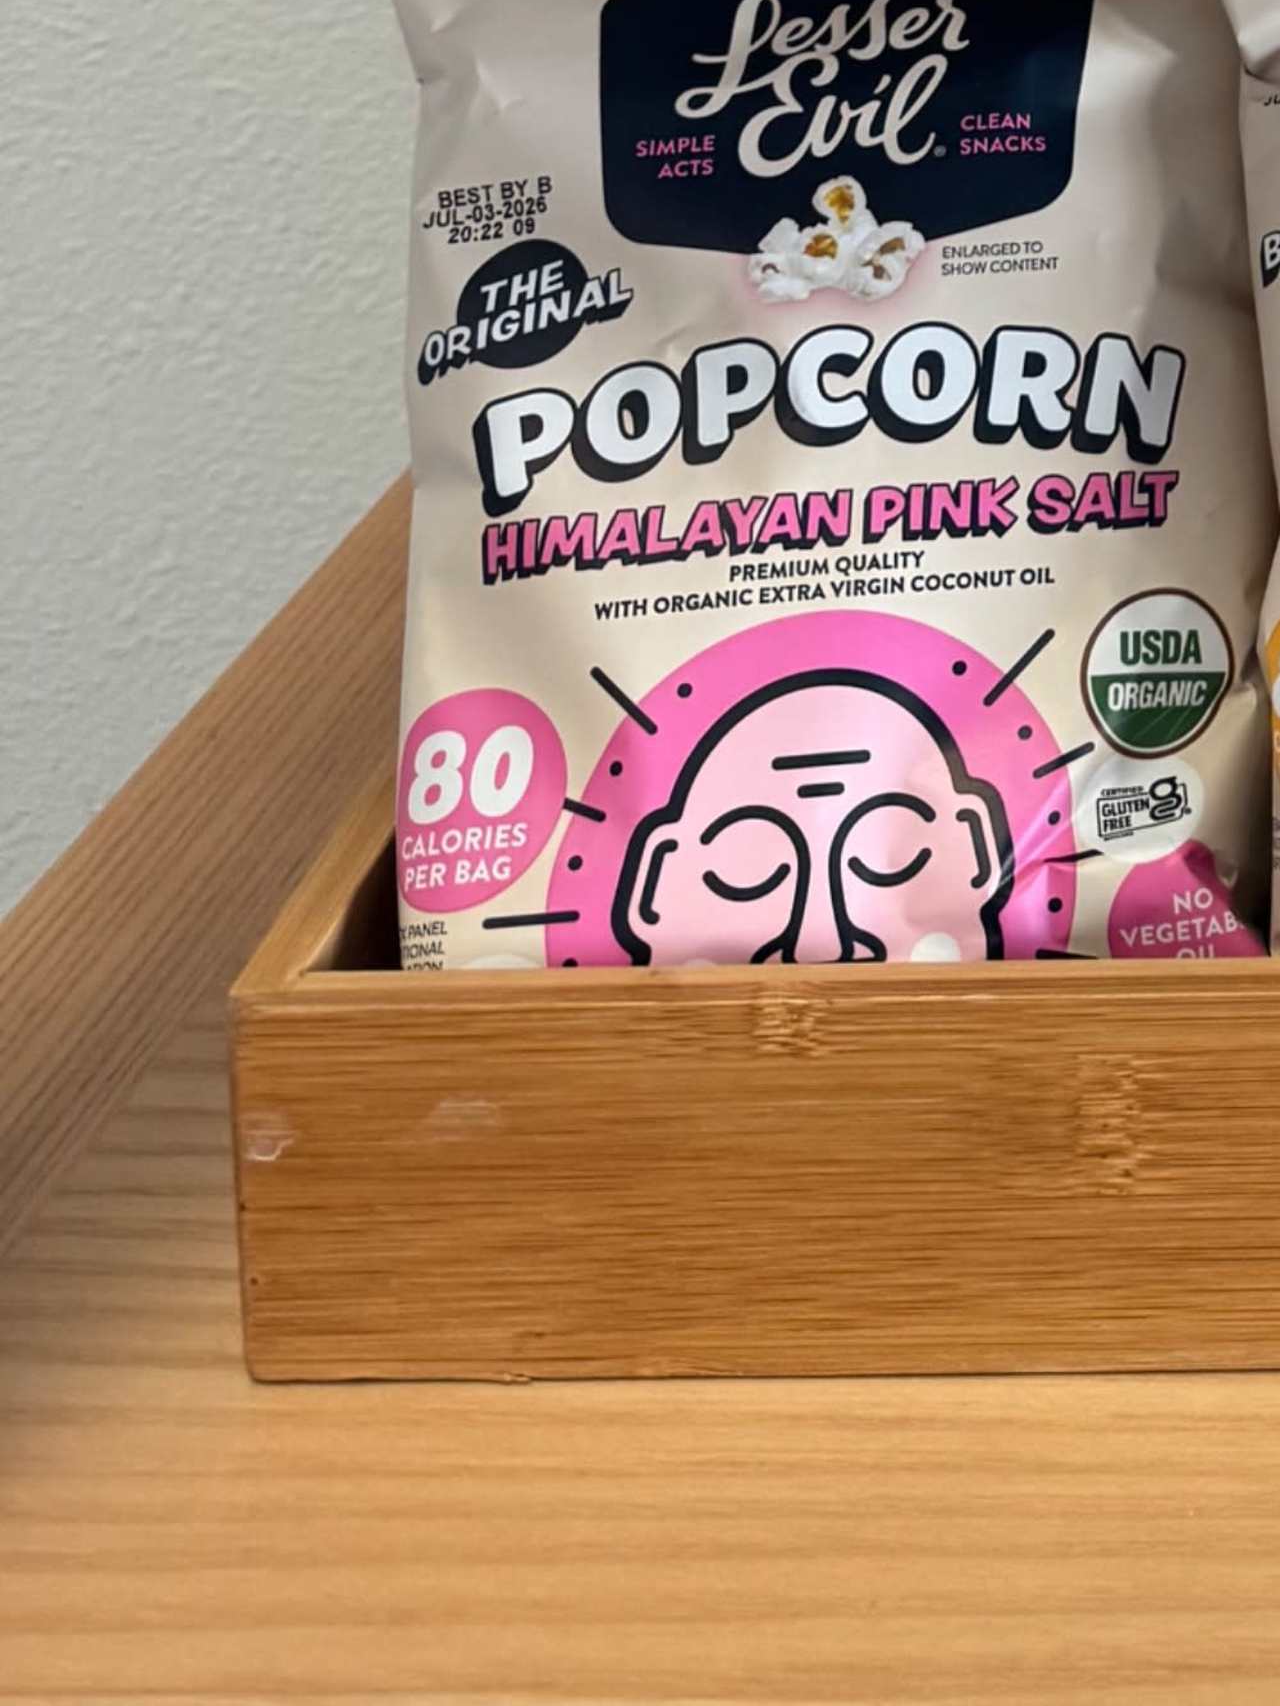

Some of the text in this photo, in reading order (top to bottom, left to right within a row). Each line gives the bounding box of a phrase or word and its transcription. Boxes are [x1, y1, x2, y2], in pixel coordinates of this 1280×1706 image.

[738, 54, 948, 178] Evil
[960, 113, 1032, 132] CLEAN
[635, 136, 715, 158] SIMPLE
[959, 136, 1046, 155] SNACKS
[658, 159, 714, 179] ACTS
[438, 176, 552, 208] BEST BY B
[423, 196, 548, 228] JUL-03-2026
[448, 218, 535, 244] 20:22 09
[941, 242, 1043, 259] ENLARGED TO
[941, 257, 1058, 276] SHOW CONTENT
[480, 260, 564, 312] THE
[419, 267, 634, 378] ORIGINAL
[473, 321, 1186, 516] POPCORN
[483, 471, 1179, 584] HIMALAYAN PINK SALT
[729, 551, 925, 582] PREMIUM QUALITY
[595, 568, 1055, 620] WITH ORGANIC EXTRA VIRGIN COCONUT OIL
[1120, 629, 1202, 666] USDA
[1108, 681, 1208, 712] ORGANIC
[408, 725, 534, 825] 80
[1102, 798, 1150, 817] GLUTEN
[1103, 817, 1133, 832] FREE
[402, 823, 528, 860] CALORIES
[404, 857, 512, 893] PER BAG
[1173, 887, 1213, 915] NO
